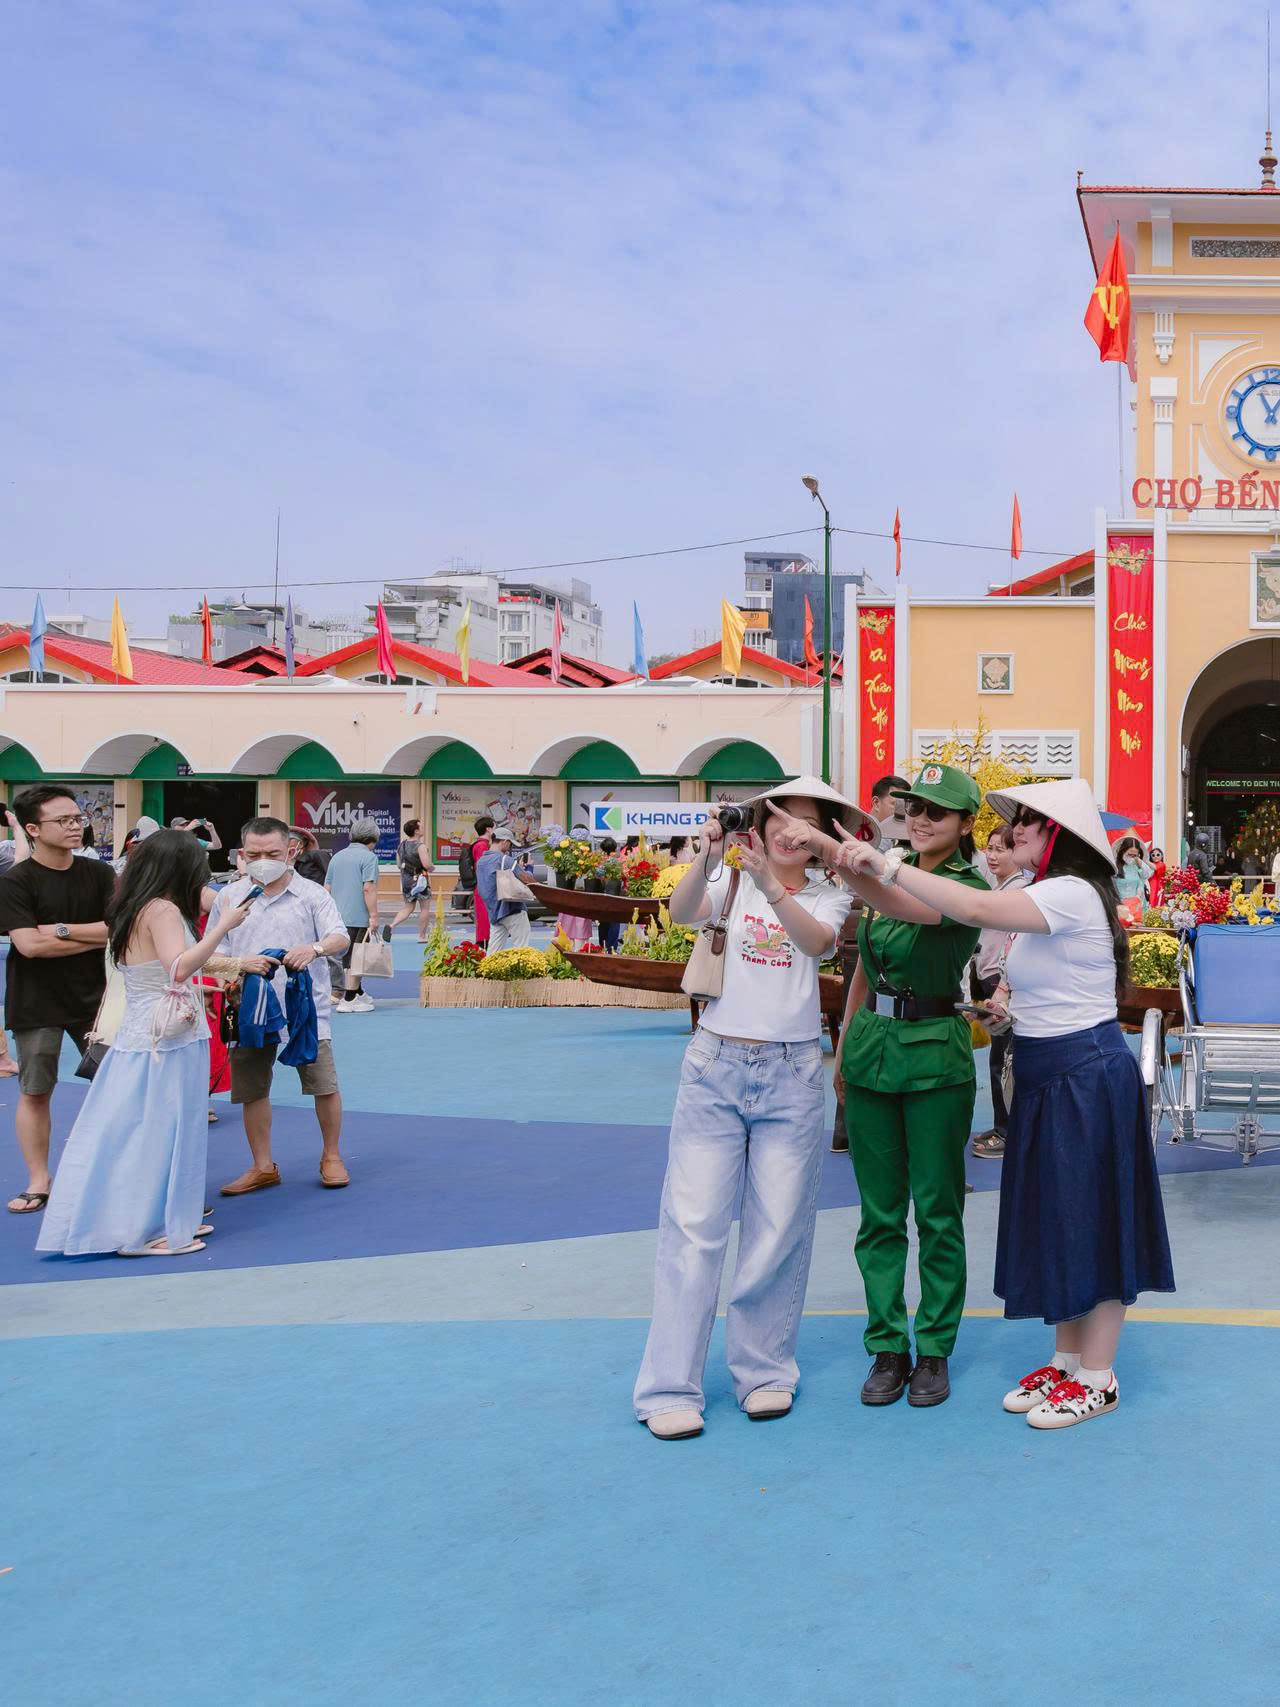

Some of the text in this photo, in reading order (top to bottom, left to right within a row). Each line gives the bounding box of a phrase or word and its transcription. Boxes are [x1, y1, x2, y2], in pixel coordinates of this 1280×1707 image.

[1225, 405, 1238, 420] 9
[1264, 447, 1277, 462] 6
[1132, 475, 1203, 513] CHỢ
[1113, 611, 1148, 632] Chúc
[302, 790, 365, 825] Vikki
[367, 809, 389, 817] Digital
[626, 812, 691, 826] KHANG
[741, 953, 792, 968] Thành Công
